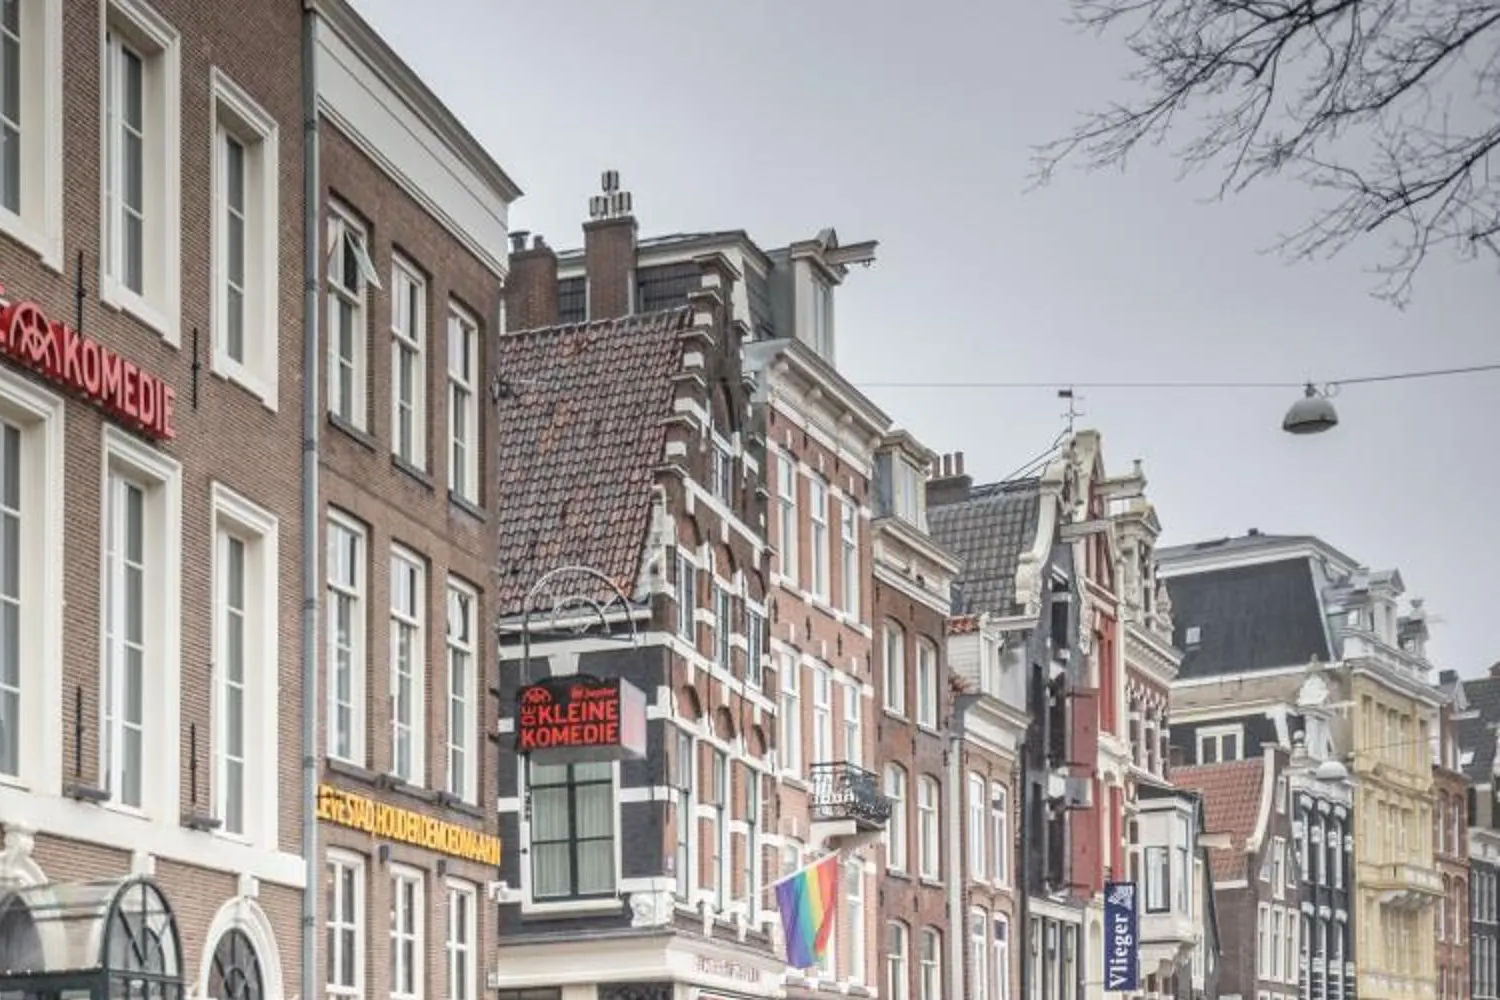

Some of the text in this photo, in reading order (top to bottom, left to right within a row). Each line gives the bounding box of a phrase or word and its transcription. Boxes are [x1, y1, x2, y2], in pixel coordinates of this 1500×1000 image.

[62, 325, 177, 438] KOMEDIE
[521, 699, 618, 726] DE KLEINE
[522, 722, 618, 749] KOMEDIE
[1109, 913, 1133, 989] Vlieger
